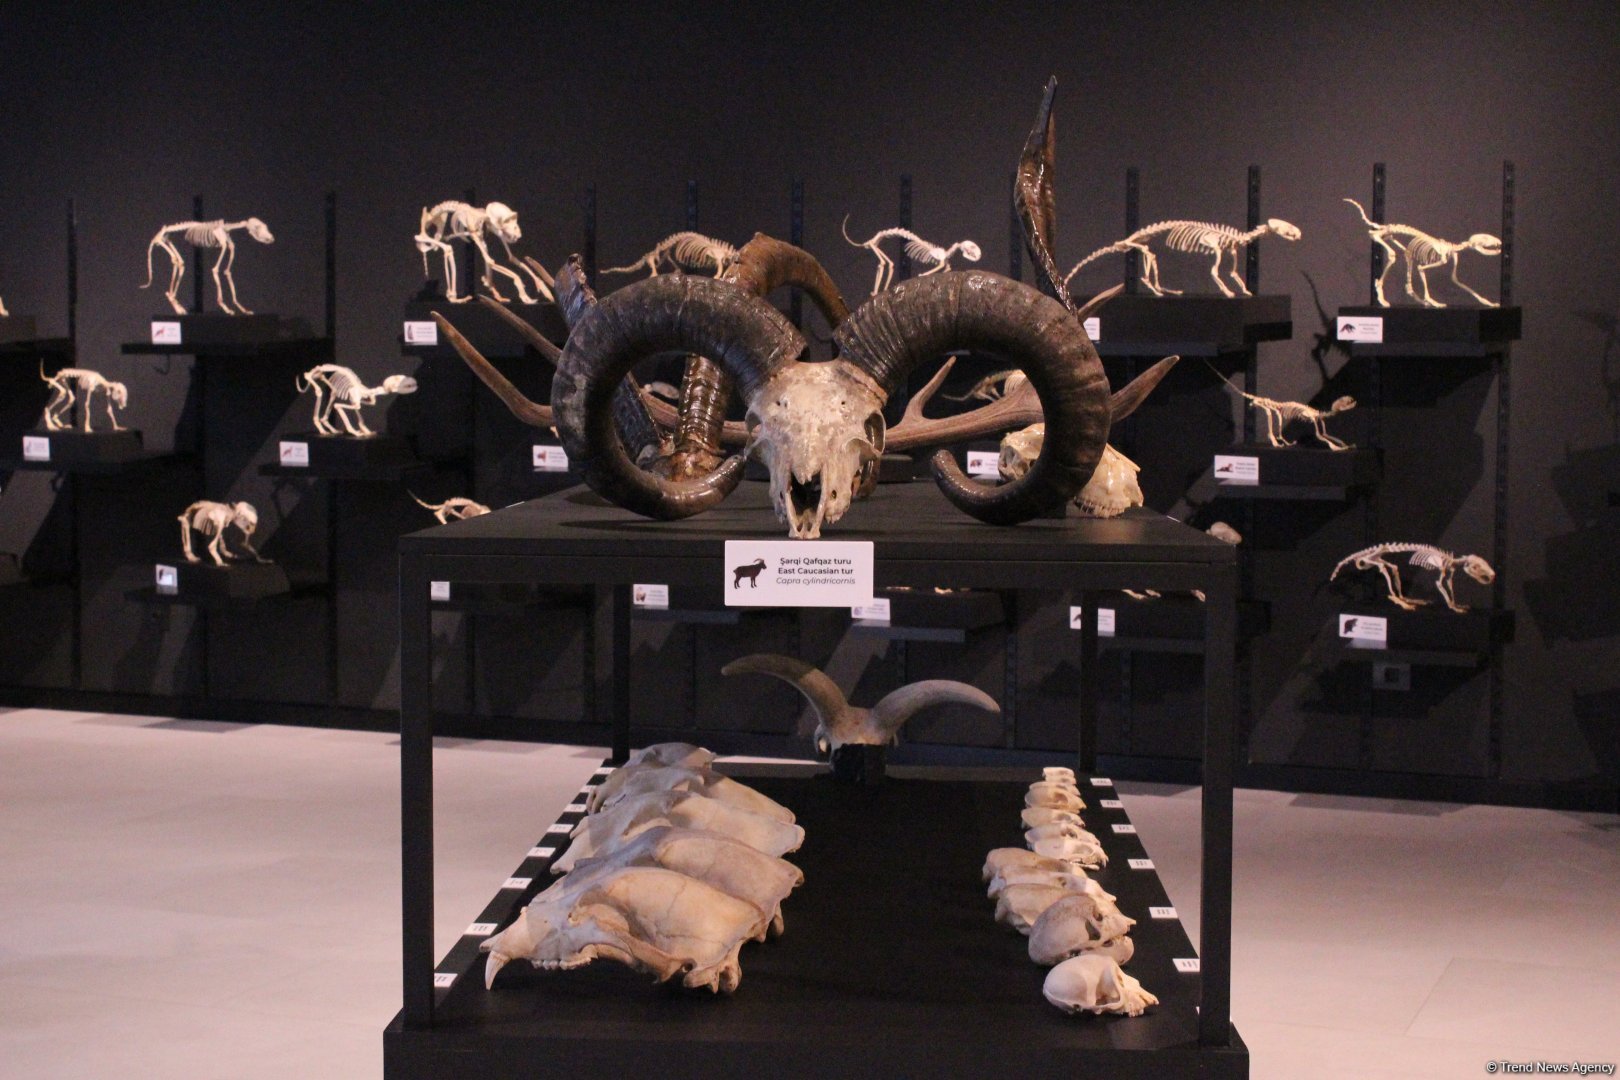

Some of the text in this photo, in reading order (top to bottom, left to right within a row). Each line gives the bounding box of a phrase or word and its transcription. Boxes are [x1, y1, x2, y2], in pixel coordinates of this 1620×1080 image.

[803, 557, 832, 566] Qafqaz
[776, 577, 856, 585] Capra cylindricornis
